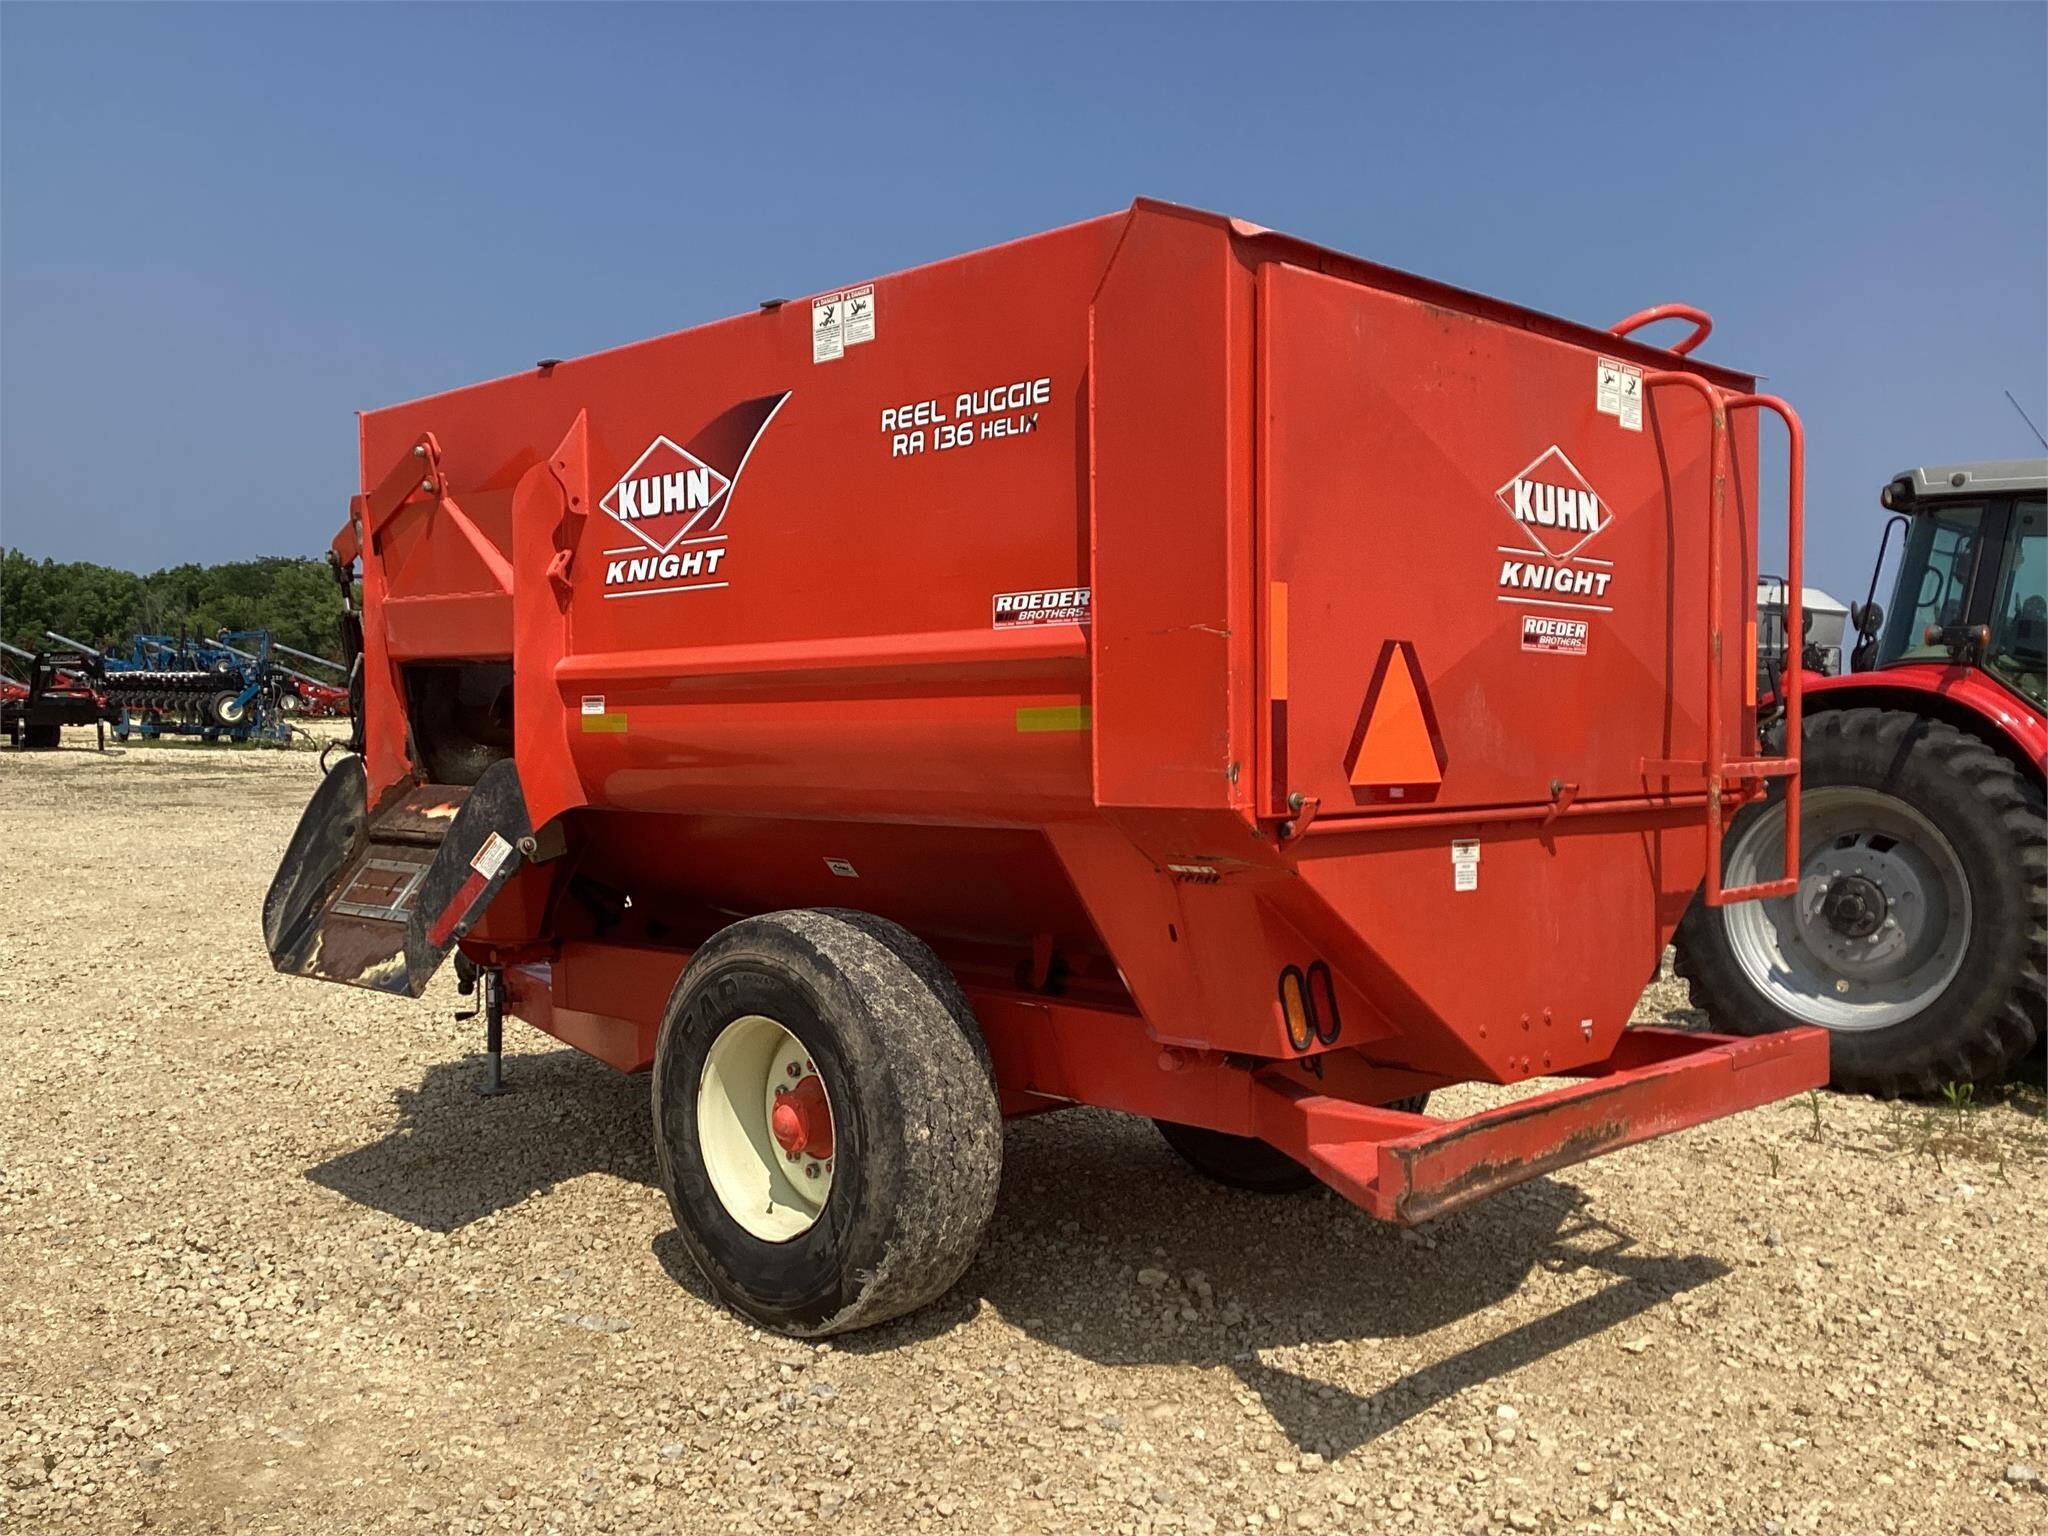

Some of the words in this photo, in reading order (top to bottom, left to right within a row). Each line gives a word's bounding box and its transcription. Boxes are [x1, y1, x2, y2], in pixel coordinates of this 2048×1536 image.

[881, 401, 946, 432] REEL
[955, 377, 1051, 418] AUGGIE
[892, 431, 925, 457] RA
[933, 421, 974, 450] 136
[981, 412, 1038, 440] HELIX
[618, 467, 710, 520] KUHN
[1514, 477, 1600, 532] KUHN
[605, 548, 725, 585] KNIGHT
[1500, 561, 1612, 597] KNIGHT
[996, 590, 1091, 612] ROEDER
[1018, 607, 1085, 621] BROTHERS
[1525, 618, 1587, 638] ROEDER
[1539, 635, 1582, 647] BROTHERS
